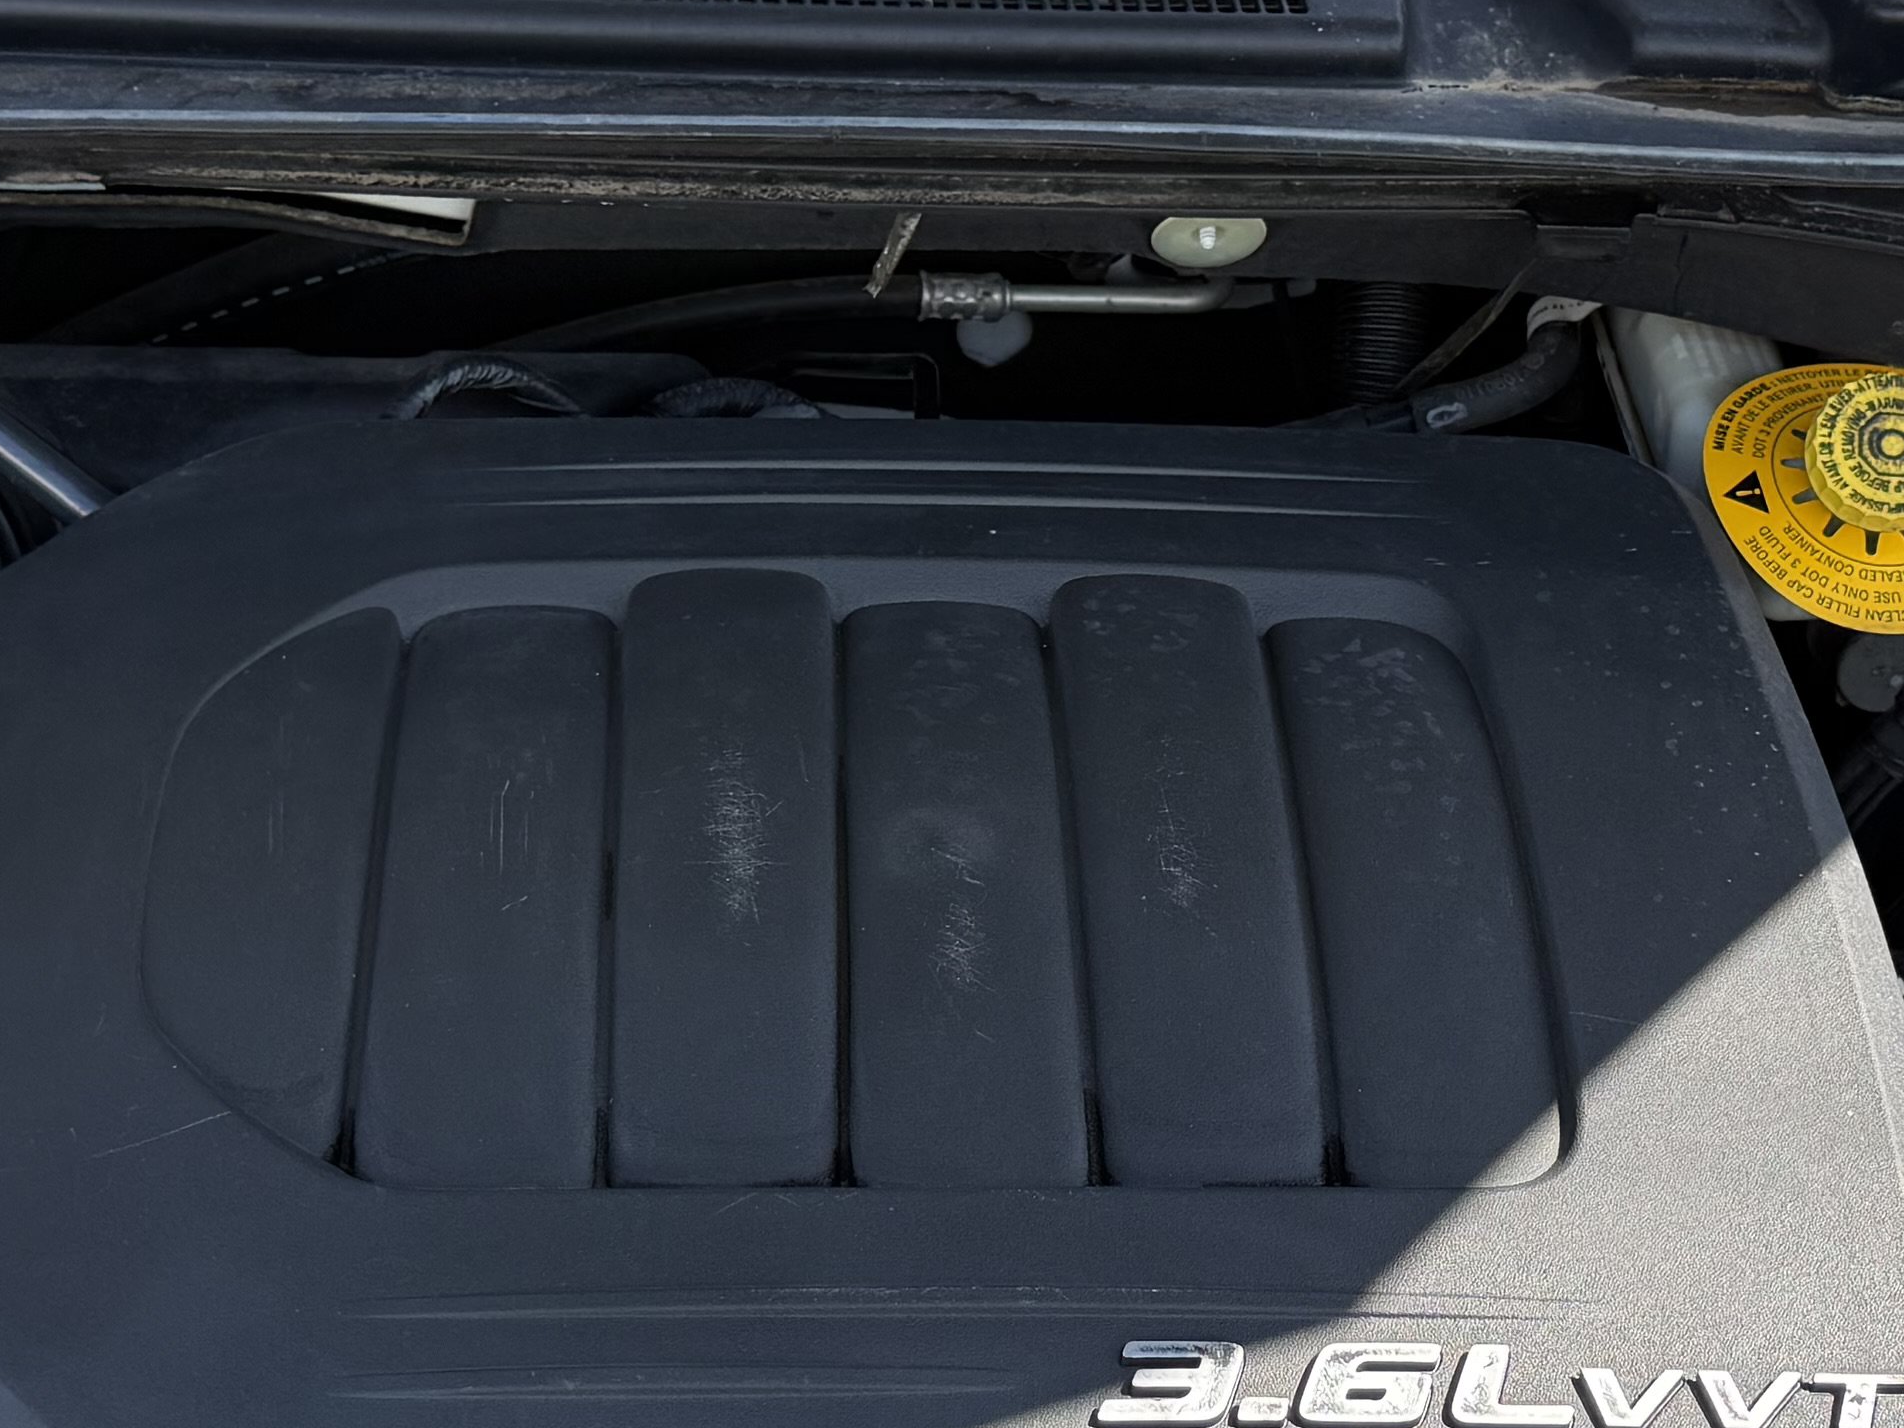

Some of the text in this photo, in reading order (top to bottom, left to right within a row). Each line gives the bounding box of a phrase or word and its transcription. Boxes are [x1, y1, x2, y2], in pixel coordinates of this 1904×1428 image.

[1731, 416, 1750, 454] AVANT
[1752, 436, 1766, 459] DOT
[1759, 525, 1792, 561] FLUID
[1743, 535, 1787, 580] BEFORE
[1800, 567, 1829, 586] DOT
[1786, 579, 1814, 599] CAP
[1832, 582, 1869, 601] ONLY
[1874, 591, 1901, 603] USE
[1816, 595, 1860, 618] FILLER
